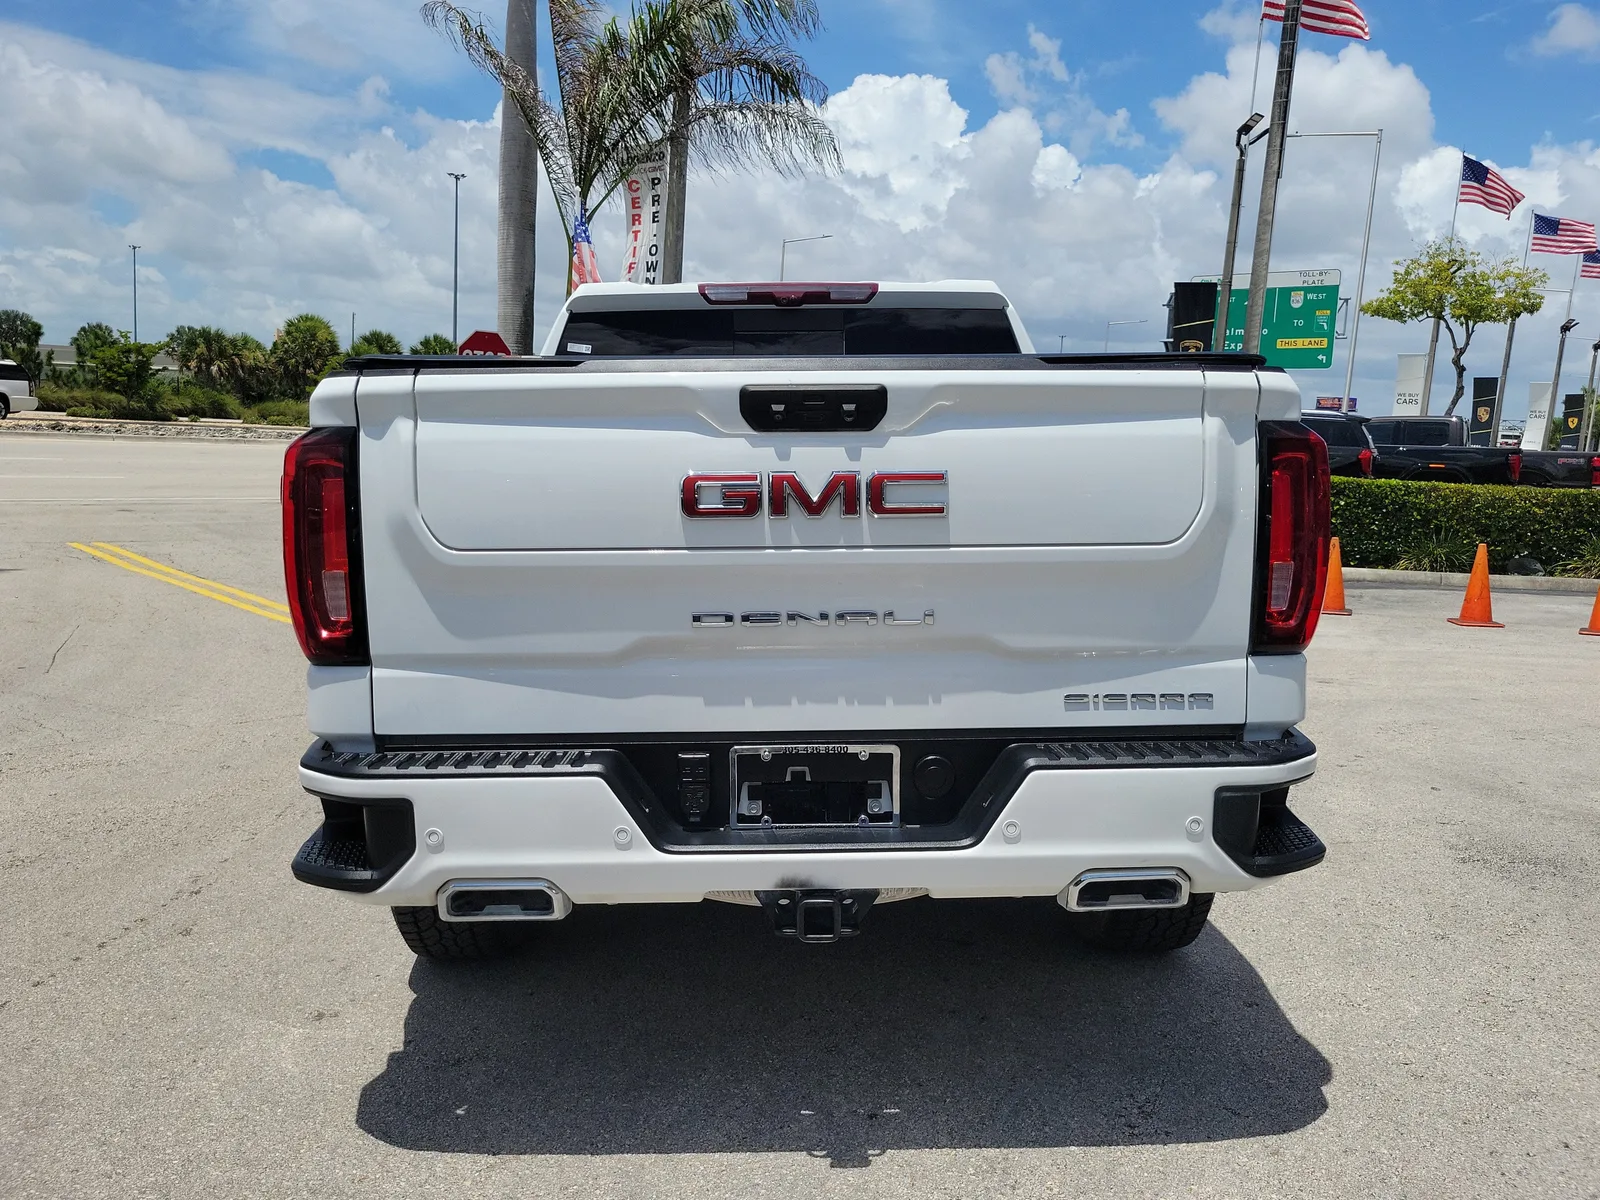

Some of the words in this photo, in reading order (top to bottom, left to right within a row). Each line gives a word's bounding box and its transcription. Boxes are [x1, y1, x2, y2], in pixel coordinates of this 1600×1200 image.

[627, 179, 642, 283] CERTIF
[1293, 319, 1304, 327] TO
[1301, 339, 1325, 347] LANE
[1396, 397, 1419, 405] CARS
[680, 470, 948, 519] GMC
[691, 610, 935, 629] DENALI
[1064, 693, 1214, 705] SIERRA
